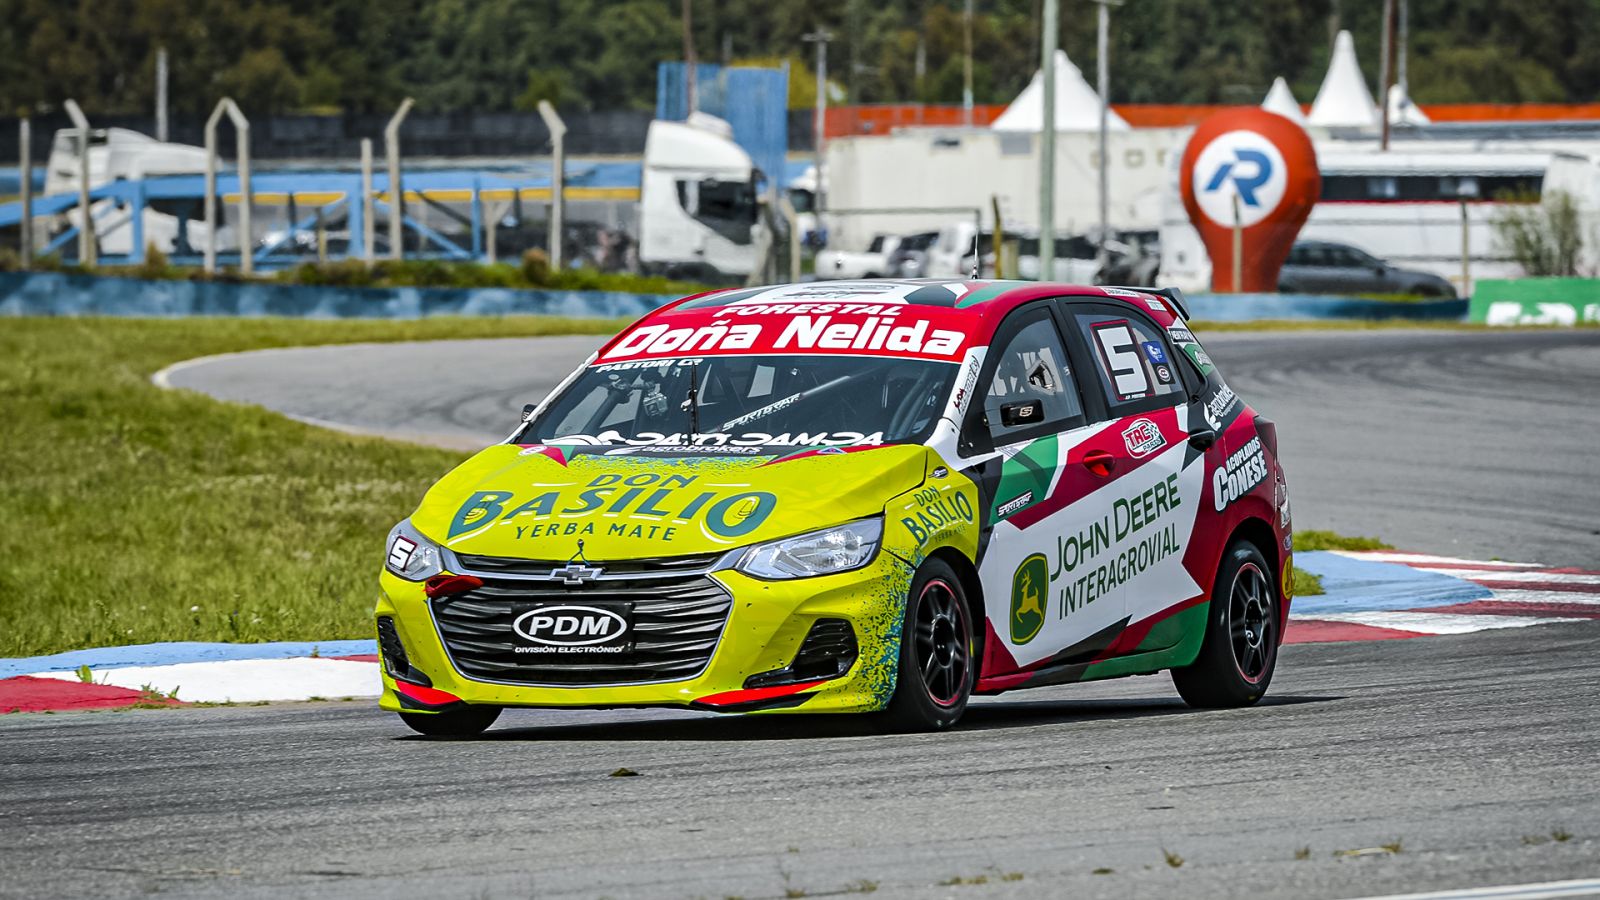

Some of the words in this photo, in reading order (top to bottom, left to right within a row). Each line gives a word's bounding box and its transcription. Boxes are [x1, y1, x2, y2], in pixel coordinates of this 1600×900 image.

[713, 303, 902, 318] FORESTAL
[600, 319, 763, 360] Doña
[773, 315, 966, 356] Nelida
[595, 359, 676, 374] PASTORI
[1097, 326, 1148, 394] 5
[1225, 436, 1261, 474] ACOPLADOS
[585, 473, 700, 489] DON
[913, 485, 942, 508] DON
[1213, 450, 1269, 512] CONESE
[446, 488, 778, 541] BASILIO
[515, 521, 594, 541] YERBA
[607, 522, 677, 542] MATE
[901, 491, 974, 546] BASILIO
[1050, 516, 1110, 583] JOHN
[1113, 472, 1182, 543] DEERE
[389, 536, 416, 570] 5
[1059, 522, 1181, 621] INTERAGROVIAL
[529, 616, 611, 636] PDM
[514, 644, 557, 654] DIVISIÓN
